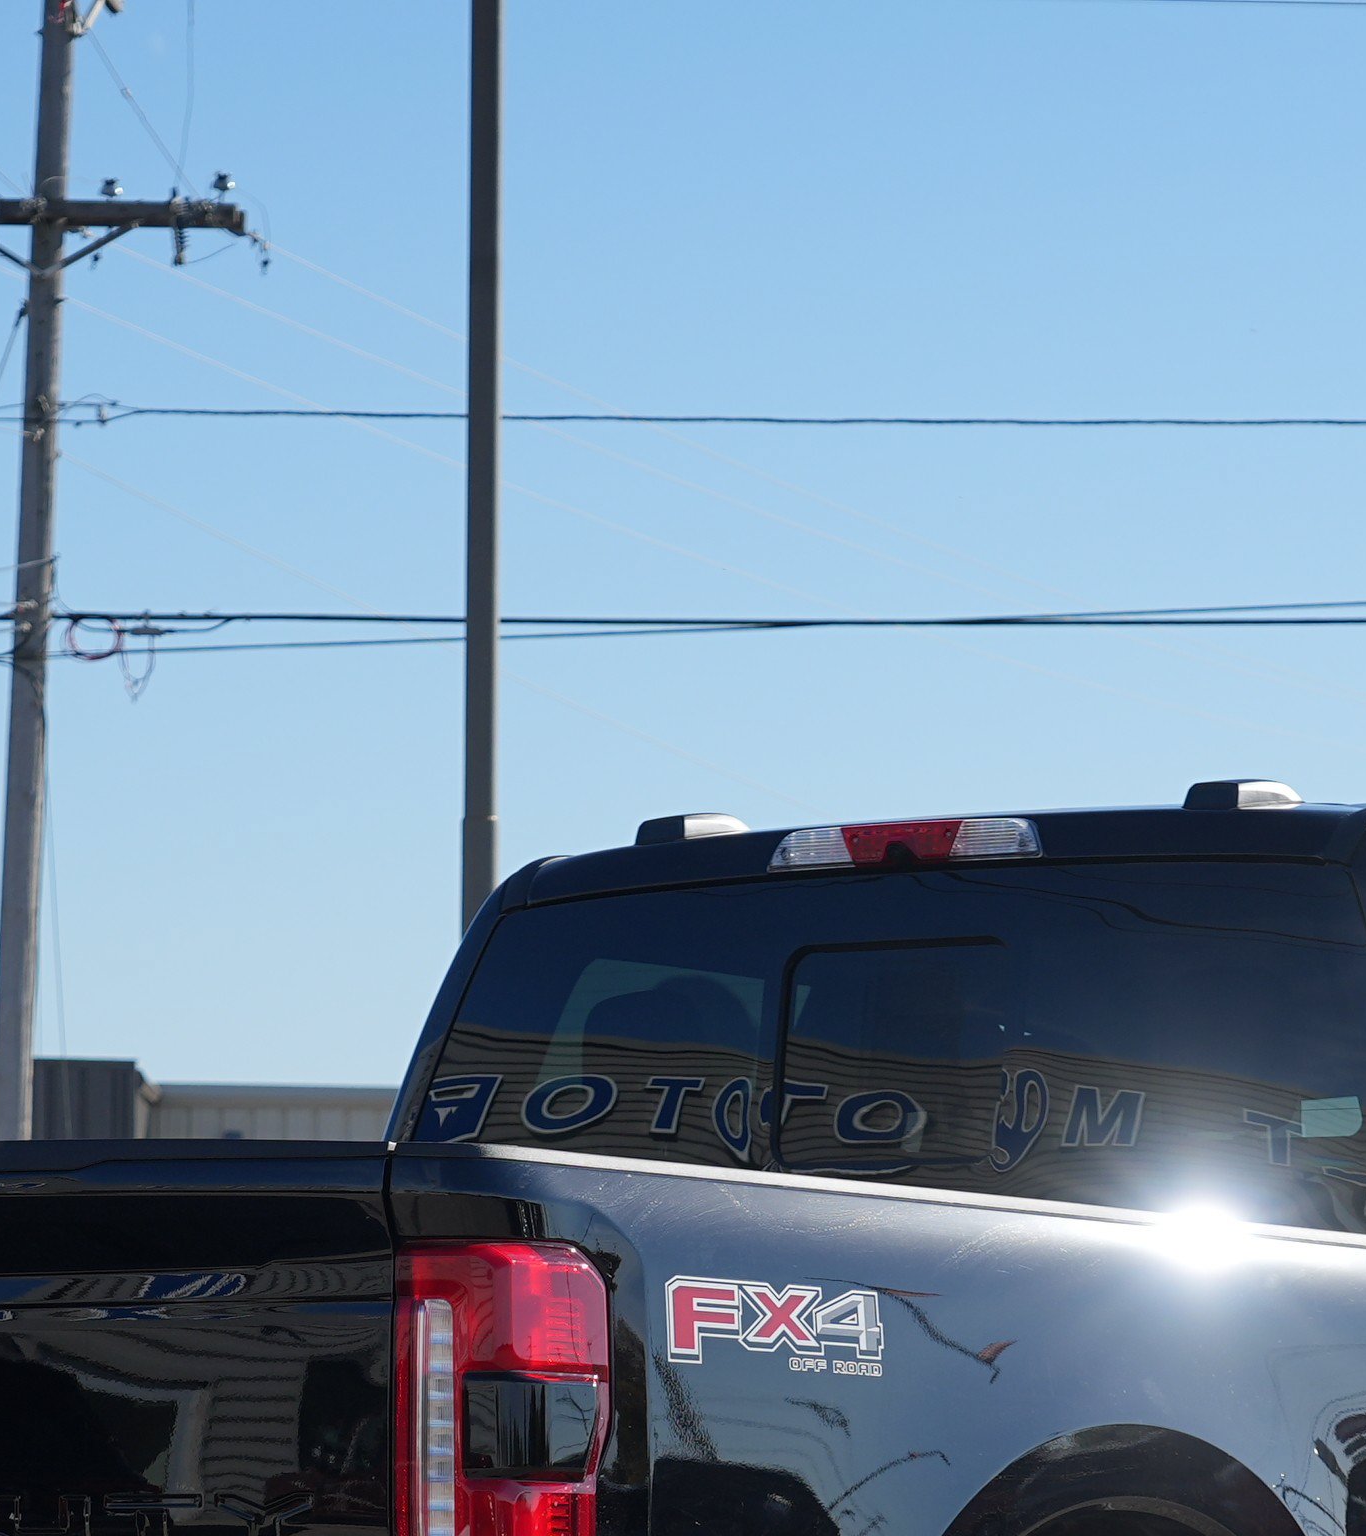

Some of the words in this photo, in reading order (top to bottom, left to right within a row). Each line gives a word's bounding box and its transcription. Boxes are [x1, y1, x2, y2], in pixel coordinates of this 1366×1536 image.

[666, 1275, 884, 1364] FX4
[789, 1357, 827, 1373] OFF
[833, 1360, 883, 1377] ROAD
